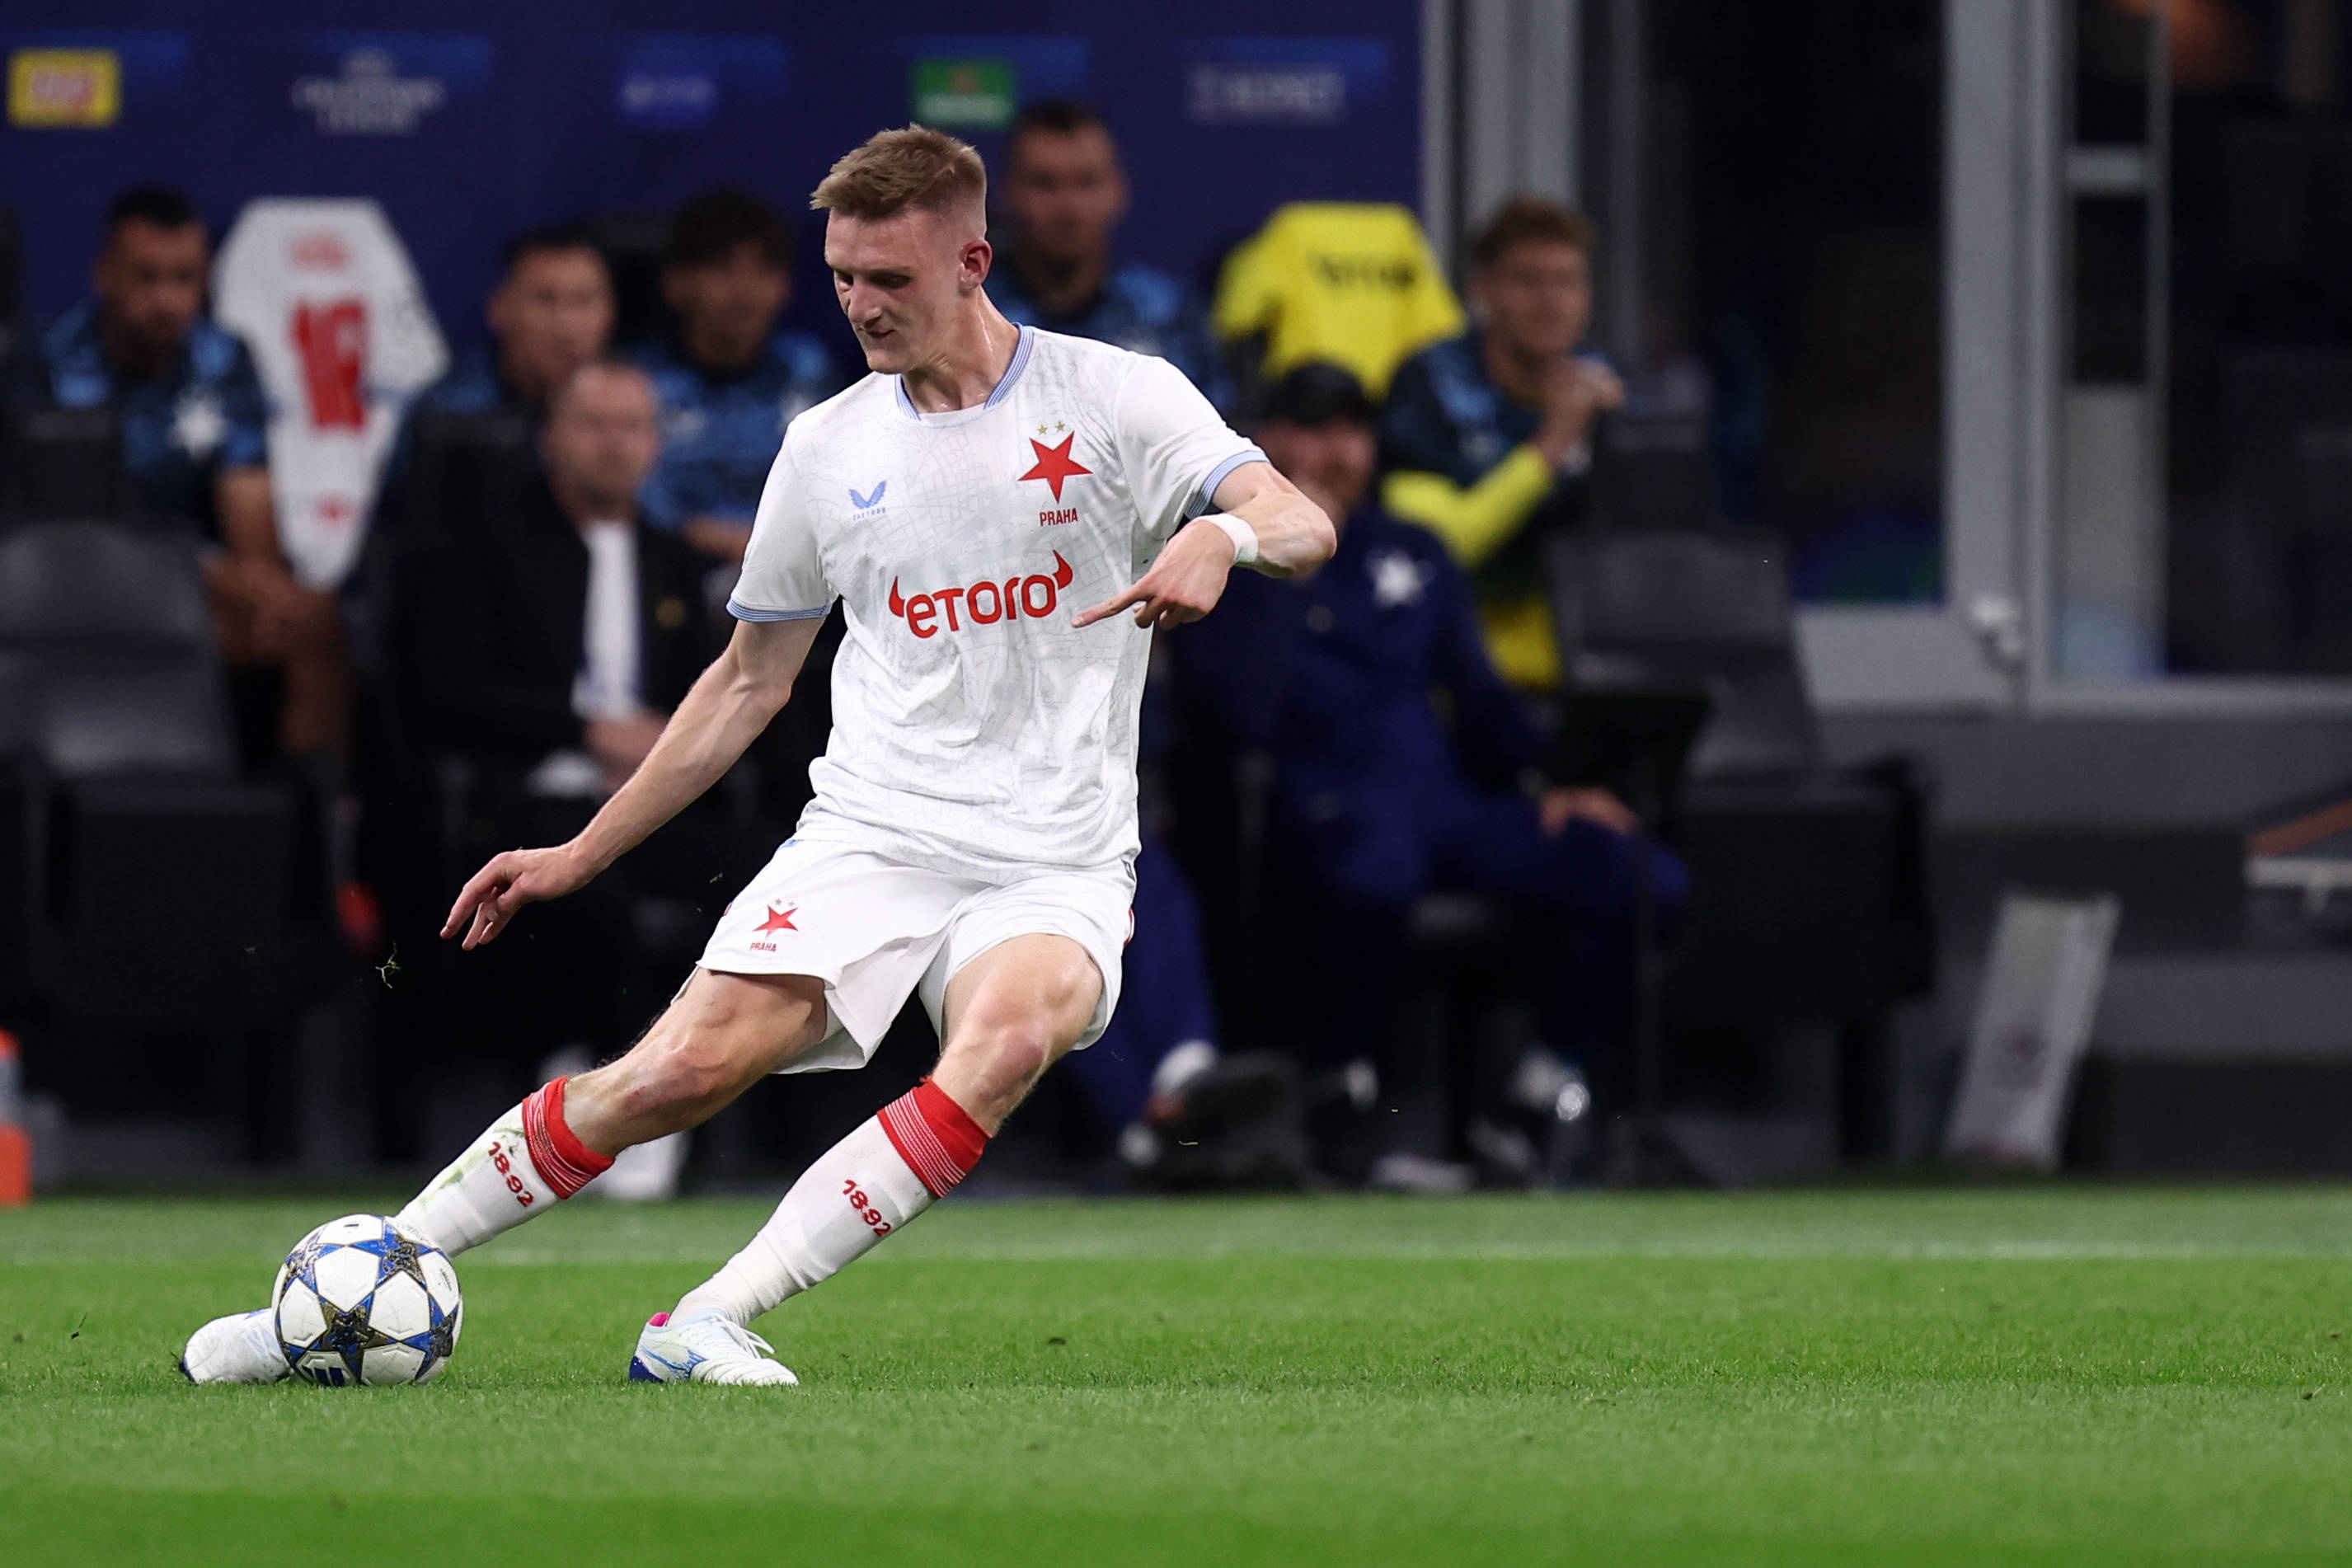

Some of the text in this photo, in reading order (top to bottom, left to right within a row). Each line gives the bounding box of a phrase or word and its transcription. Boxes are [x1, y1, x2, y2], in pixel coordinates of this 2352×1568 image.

[1040, 508, 1078, 527] PRAHA
[749, 941, 777, 952] PRAHA
[488, 1141, 534, 1208] 1892
[843, 1179, 892, 1237] 1892
